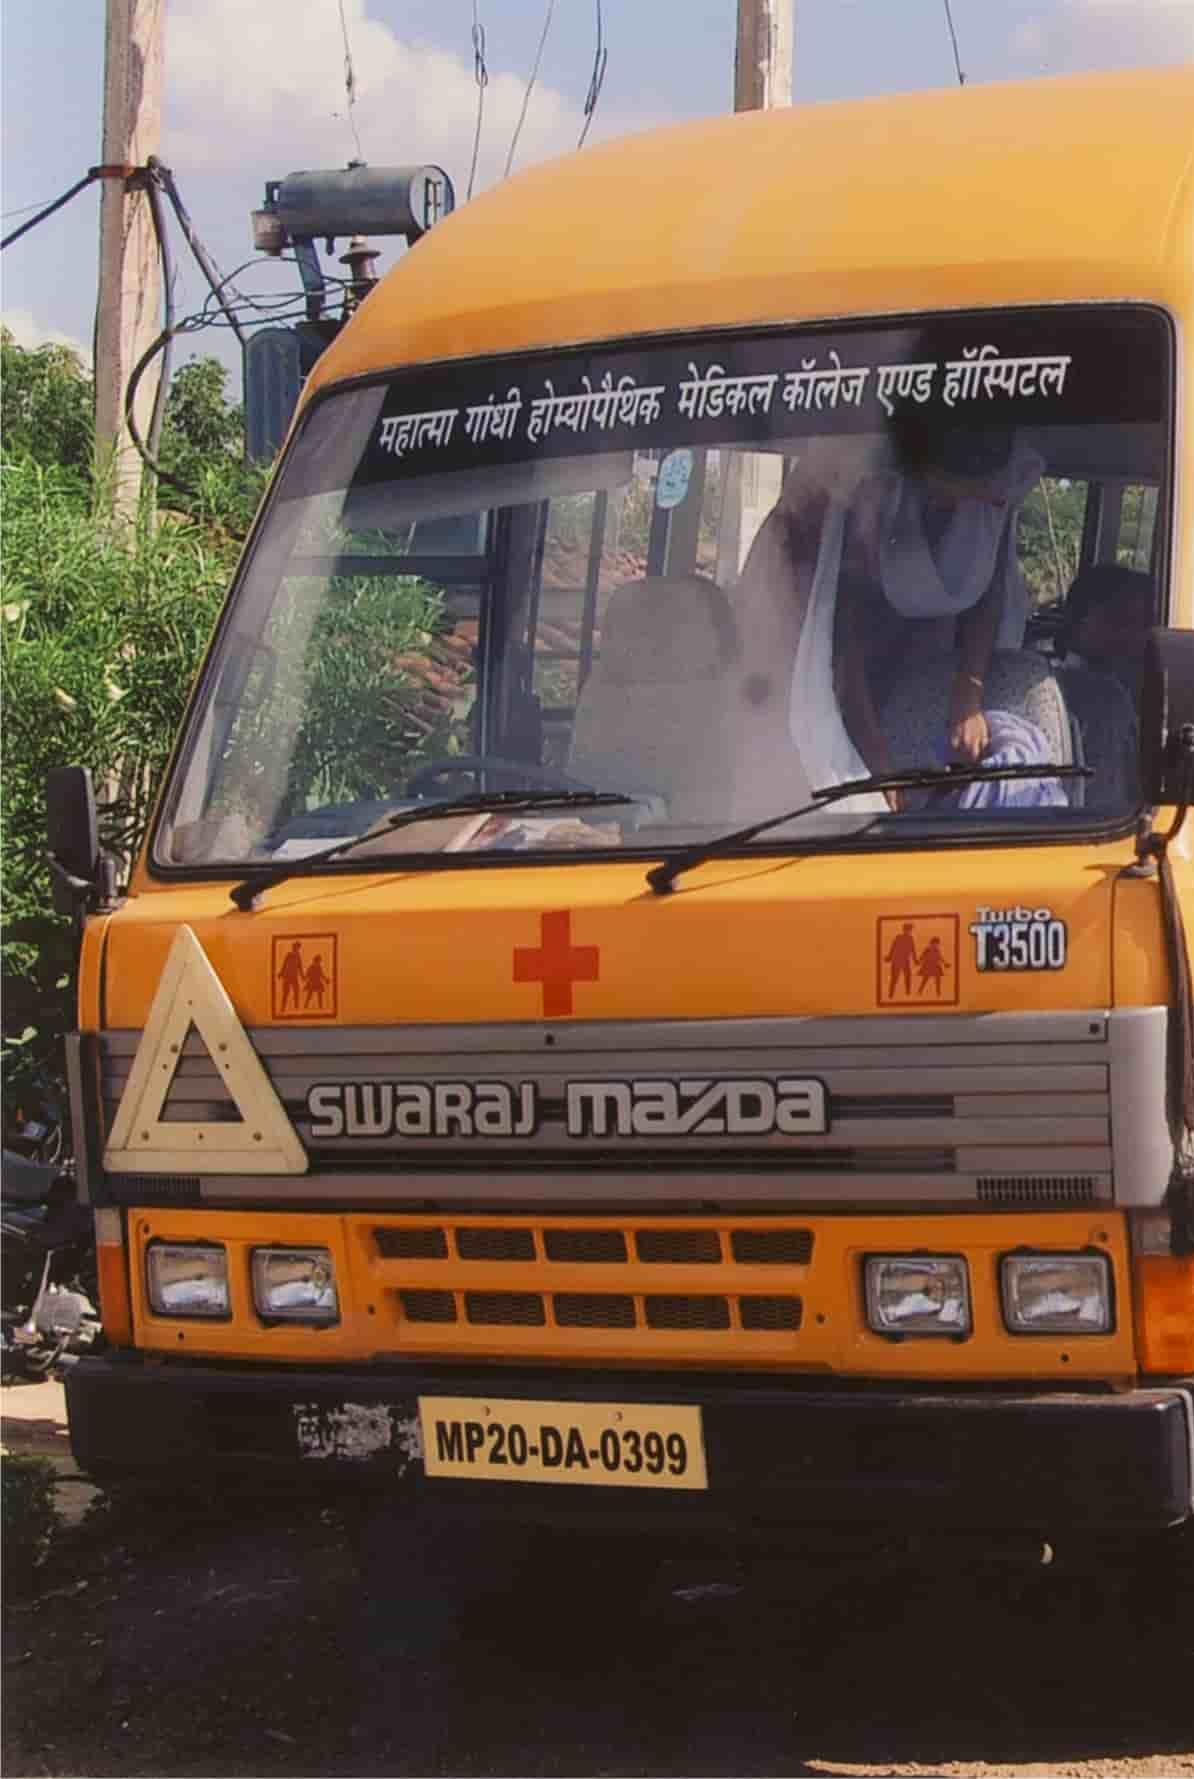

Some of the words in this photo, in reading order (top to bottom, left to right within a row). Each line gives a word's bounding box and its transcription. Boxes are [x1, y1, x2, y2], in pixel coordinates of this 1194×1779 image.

[379, 408, 459, 456] महात्मा
[464, 386, 522, 443] गांधी
[526, 371, 664, 442] होम्योपैथिक
[677, 362, 778, 419] मेडिकल
[782, 352, 870, 411] कॉलेज
[876, 362, 937, 416] एण्ड
[942, 344, 1072, 406] हॉस्पिटल
[975, 907, 1051, 922] Turbo
[969, 921, 1066, 970] T3500
[435, 1420, 688, 1476] MP20-DA-0399
